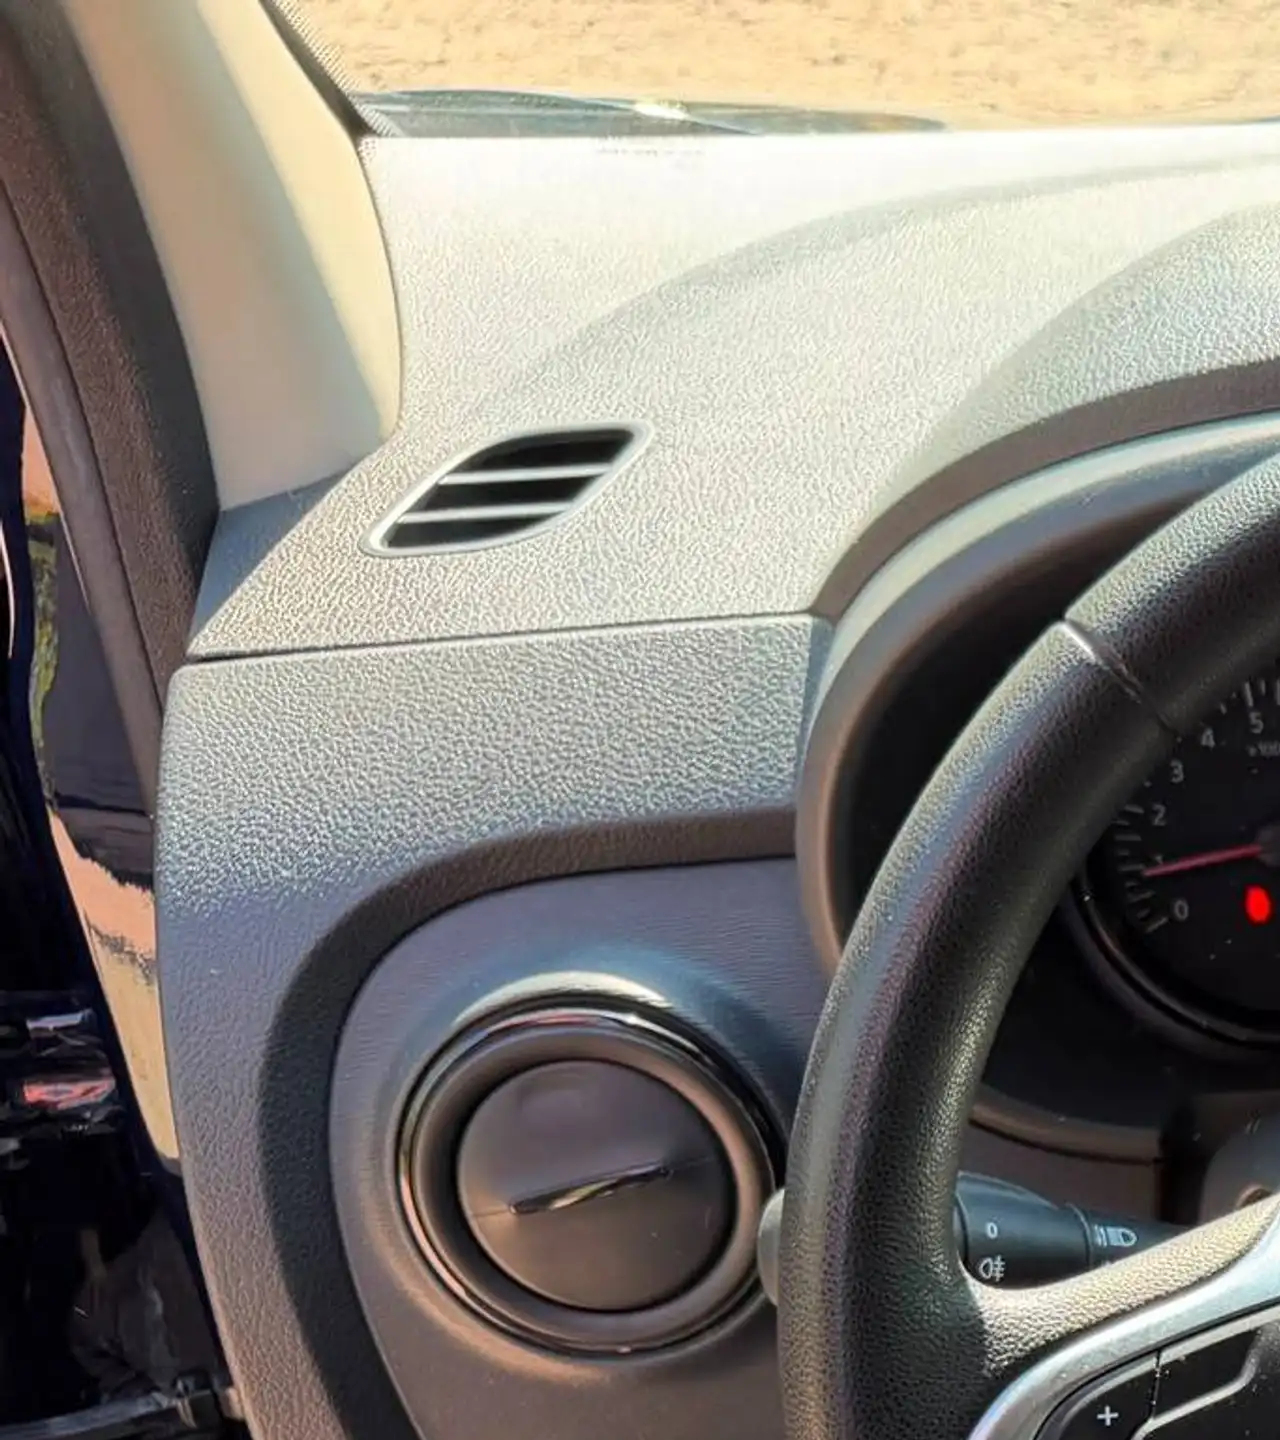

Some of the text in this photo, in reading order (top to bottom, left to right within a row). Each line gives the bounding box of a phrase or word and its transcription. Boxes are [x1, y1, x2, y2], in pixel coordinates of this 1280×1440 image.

[1248, 711, 1264, 734] 5
[1169, 759, 1184, 783] 3
[1151, 803, 1167, 826] 2
[1173, 897, 1190, 922] 0
